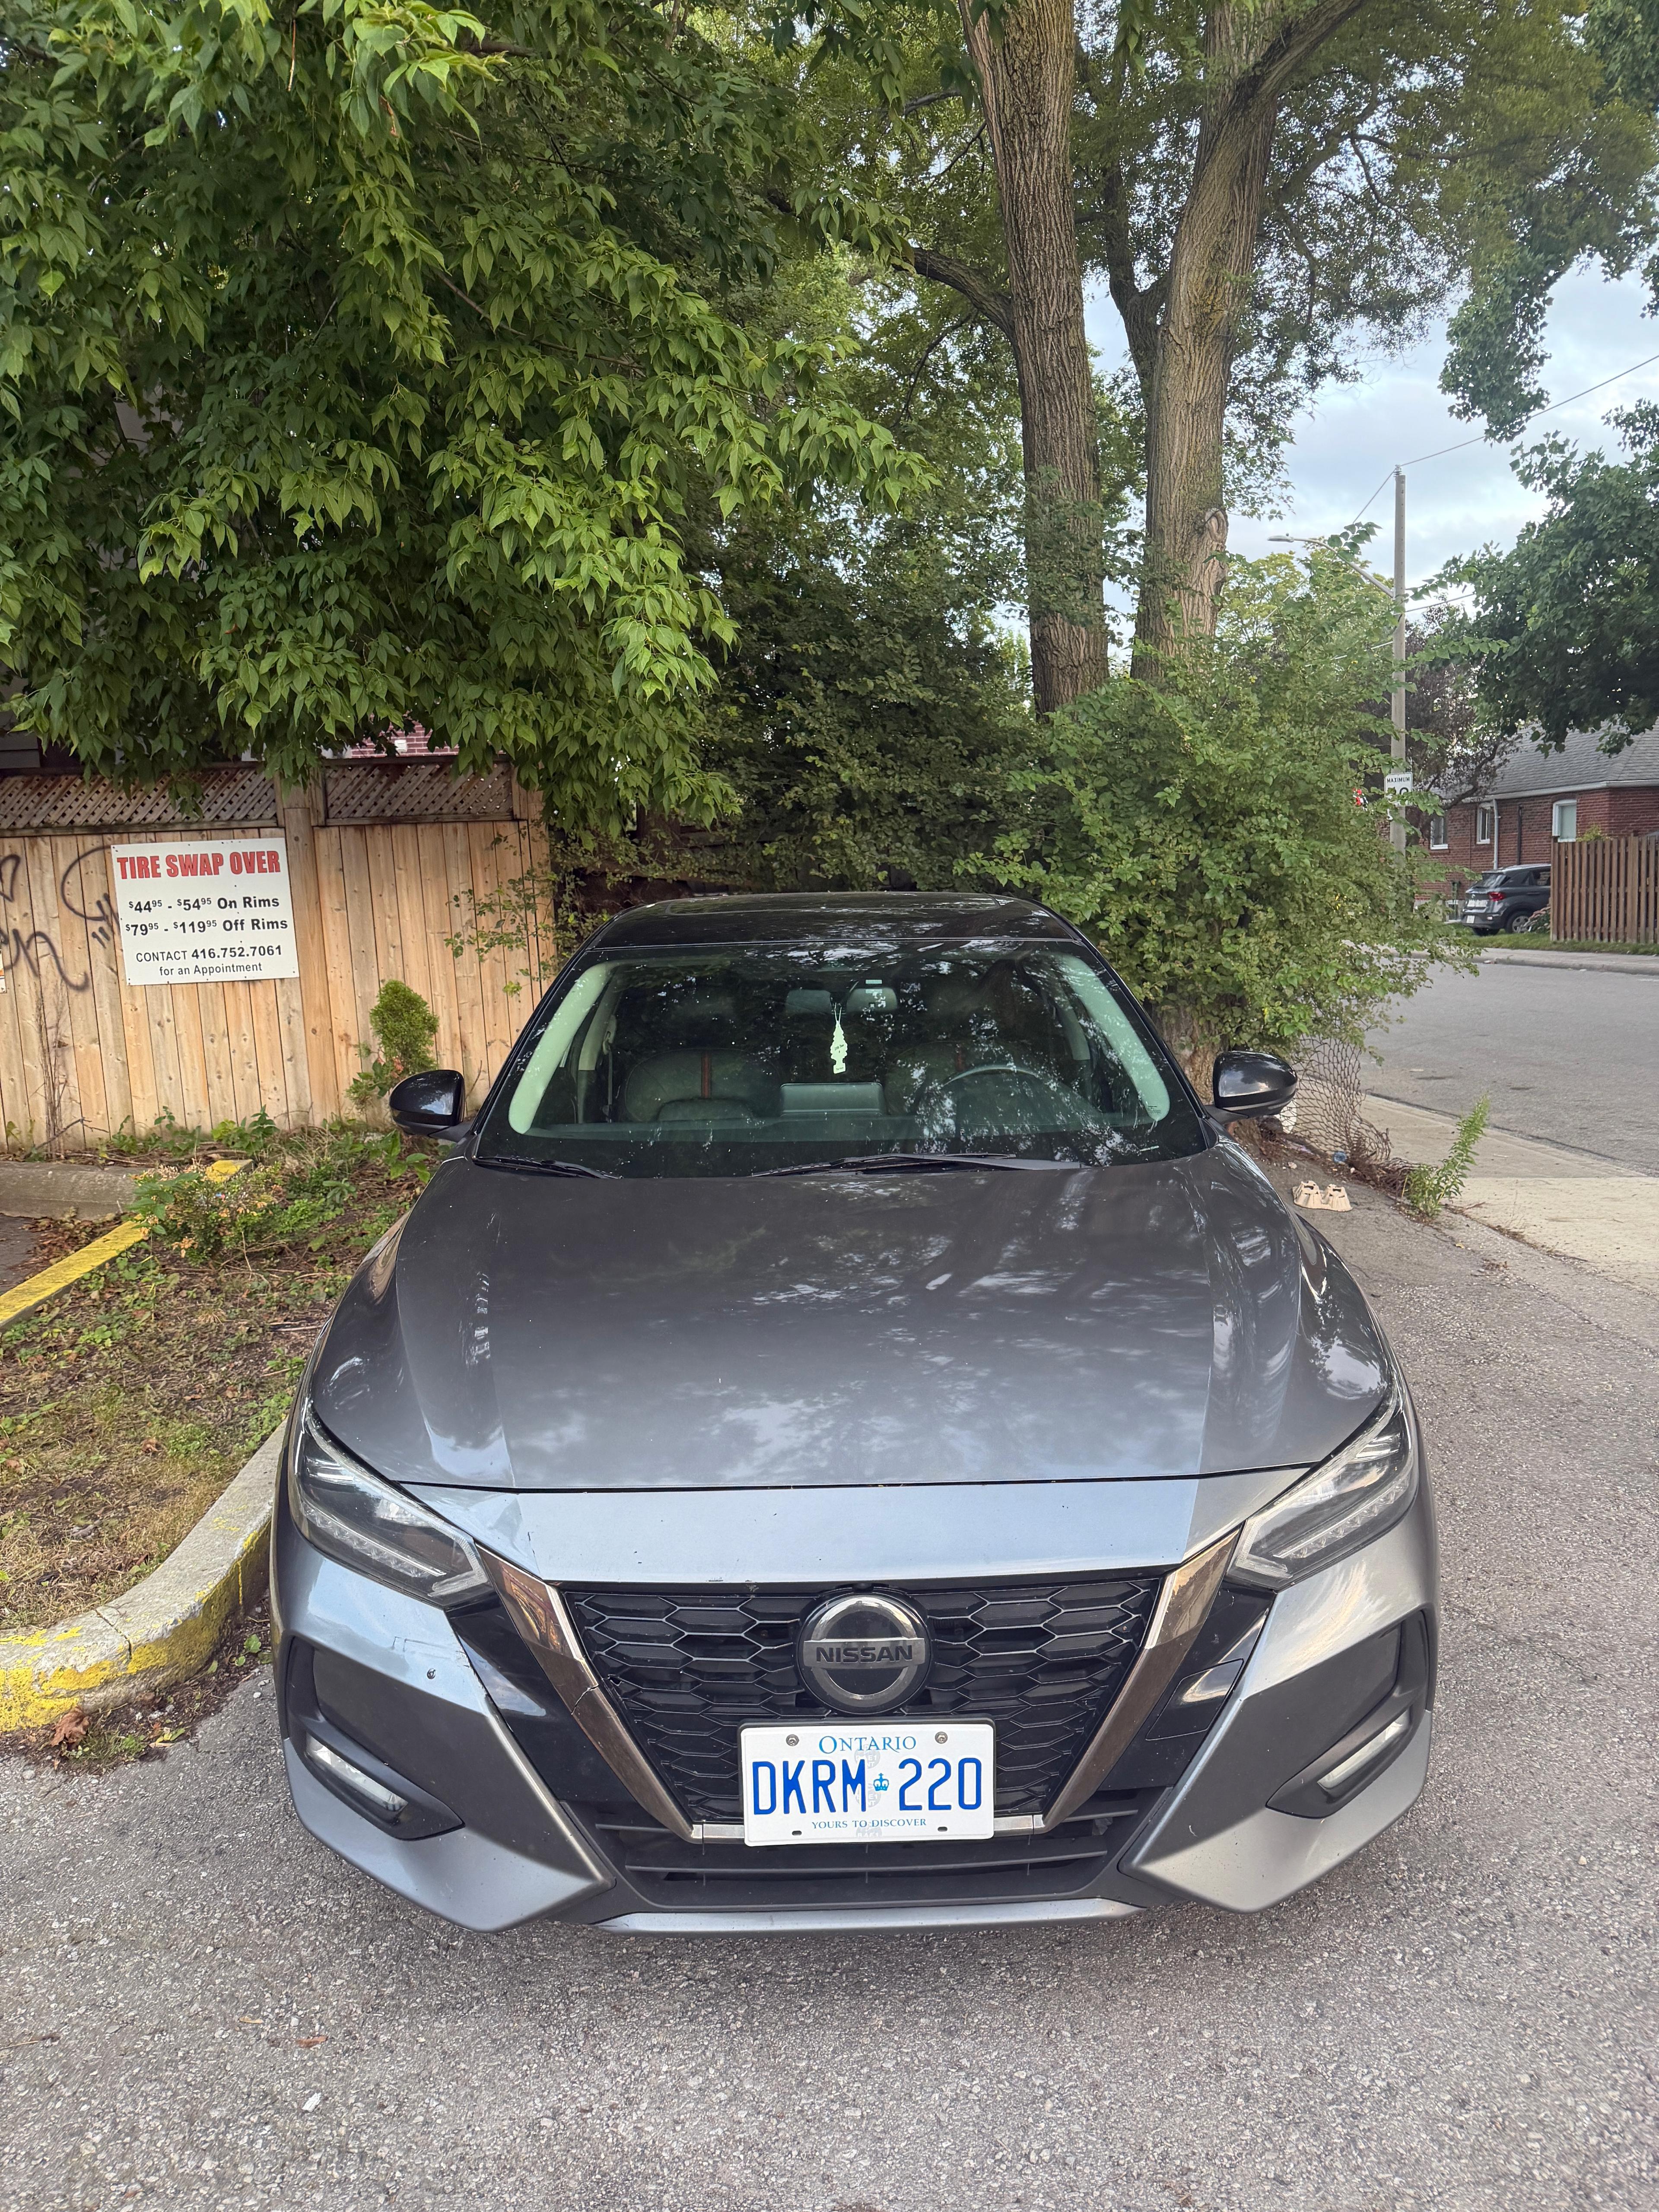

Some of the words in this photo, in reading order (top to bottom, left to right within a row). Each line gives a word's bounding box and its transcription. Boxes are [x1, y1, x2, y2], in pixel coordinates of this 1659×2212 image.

[117, 856, 161, 879] TIRE
[165, 853, 224, 877] SWAP
[229, 851, 281, 874] OVER
[217, 897, 237, 909] On
[242, 896, 280, 908] Rims
[222, 919, 245, 931] Off
[251, 918, 288, 930] Rims
[136, 950, 188, 962] CONTACT
[191, 945, 282, 959] 416.752.7061
[159, 966, 174, 976] for
[194, 963, 262, 976] Appointment
[816, 1645, 912, 1663] NISSAN
[819, 1735, 917, 1754] ONTARIO
[752, 1759, 866, 1815] DKRM
[899, 1758, 982, 1811] 220
[811, 1821, 848, 1829] YOURS
[872, 1818, 927, 1827] DISCOVER
